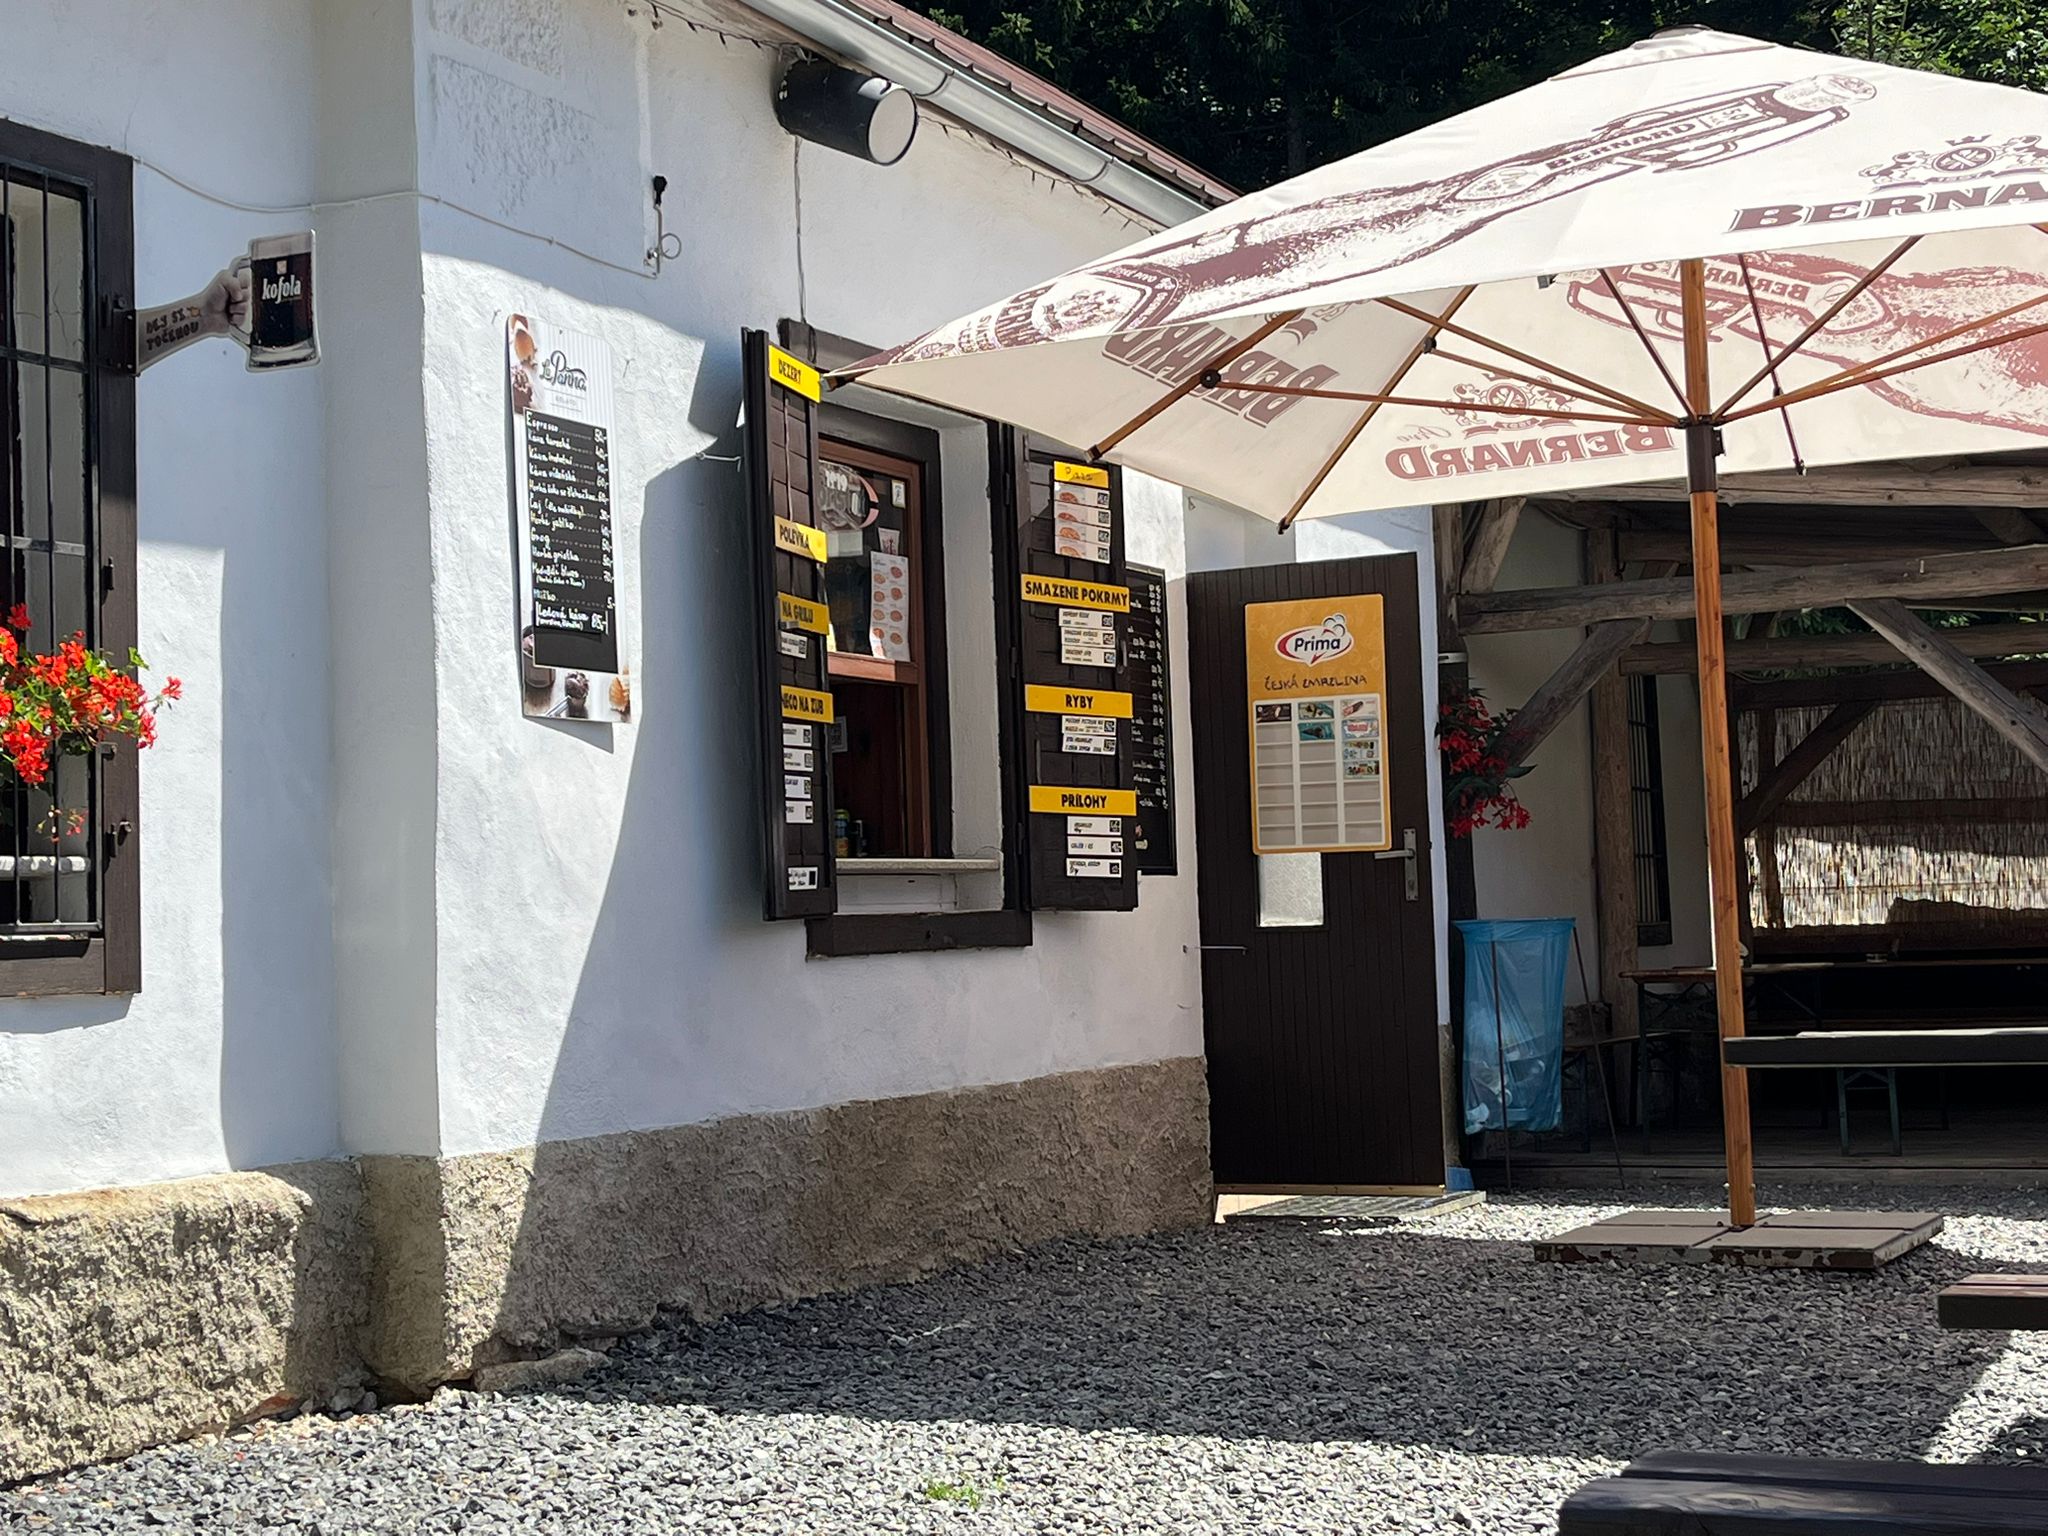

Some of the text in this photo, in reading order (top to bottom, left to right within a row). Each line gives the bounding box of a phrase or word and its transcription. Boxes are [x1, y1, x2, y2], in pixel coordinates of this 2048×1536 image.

[262, 274, 302, 304] kofola
[1081, 587, 1128, 606] POKRMY
[1294, 636, 1341, 652] Prima
[1065, 693, 1094, 709] RYBY
